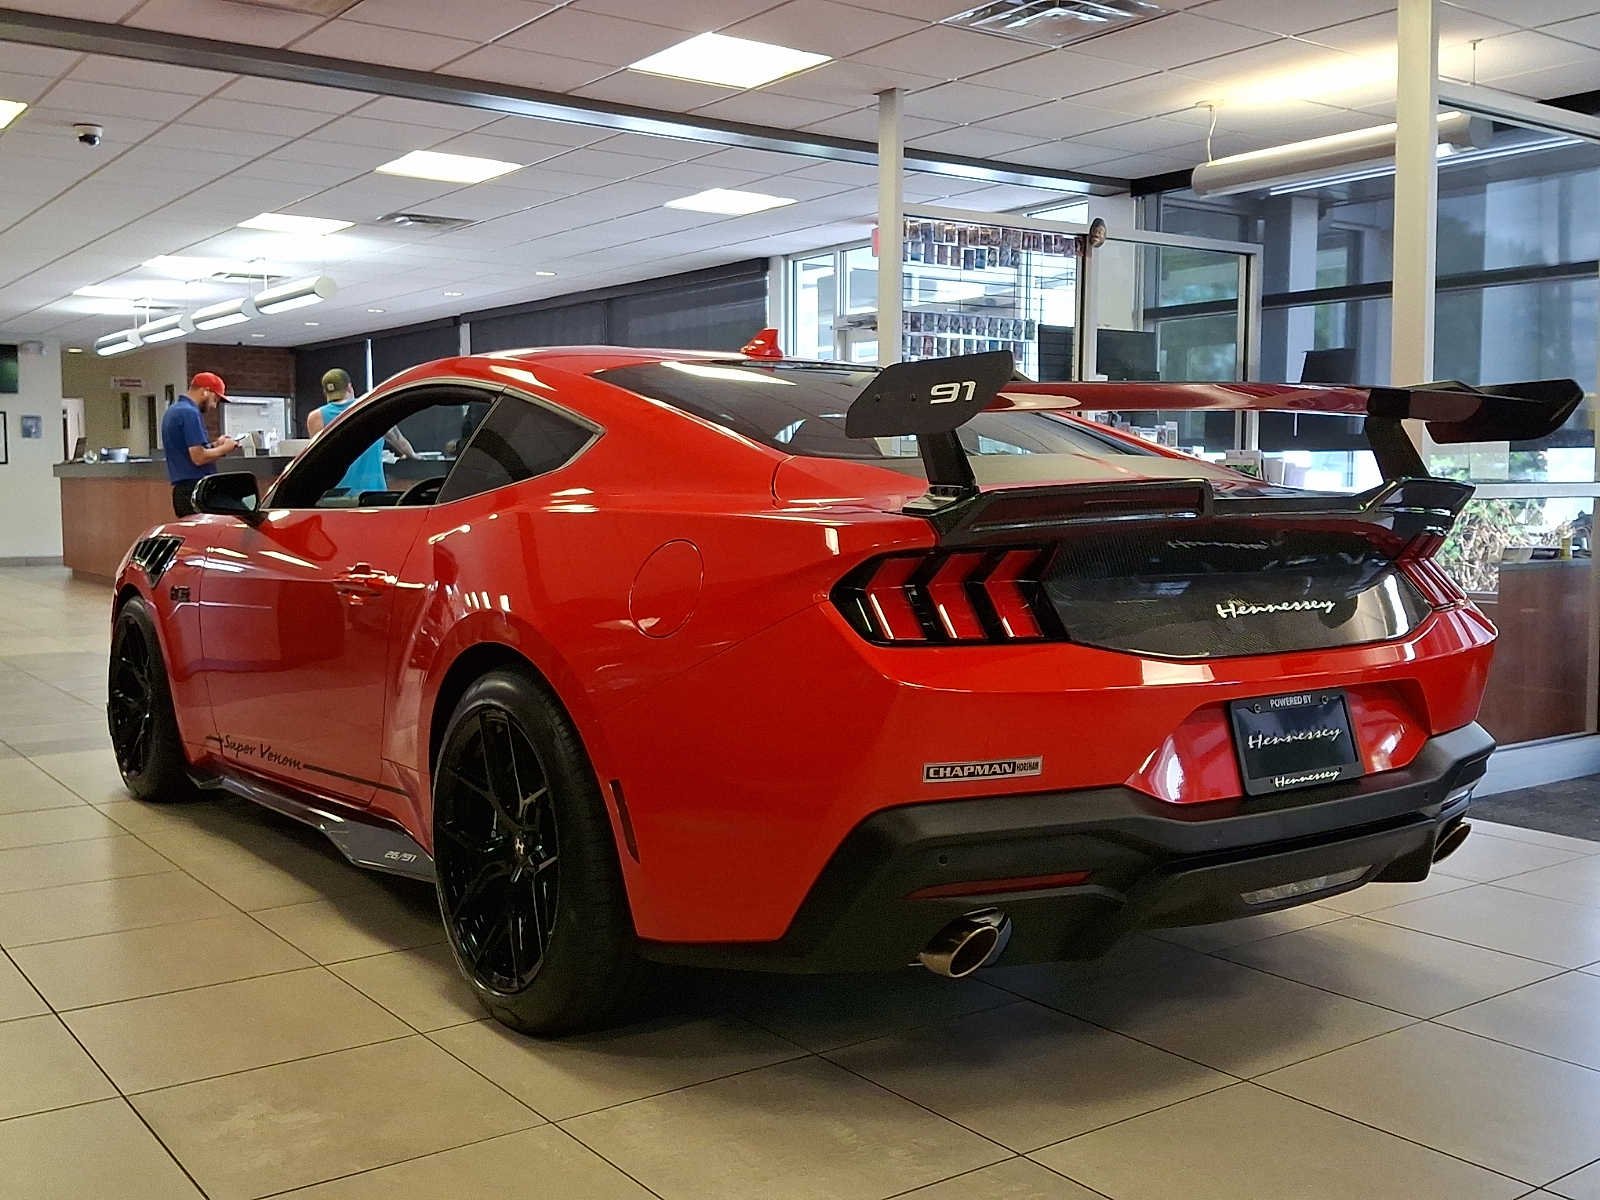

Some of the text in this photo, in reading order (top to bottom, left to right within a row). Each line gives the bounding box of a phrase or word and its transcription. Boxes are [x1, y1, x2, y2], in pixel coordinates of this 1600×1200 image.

[930, 380, 977, 405] 91
[1215, 598, 1336, 619] Hennessey
[1269, 694, 1313, 708] POWERED BY
[1247, 727, 1343, 749] Hennessey
[223, 734, 302, 770] Super Venom
[928, 762, 1014, 778] CHAPMAN
[1274, 769, 1341, 788] Hennessey
